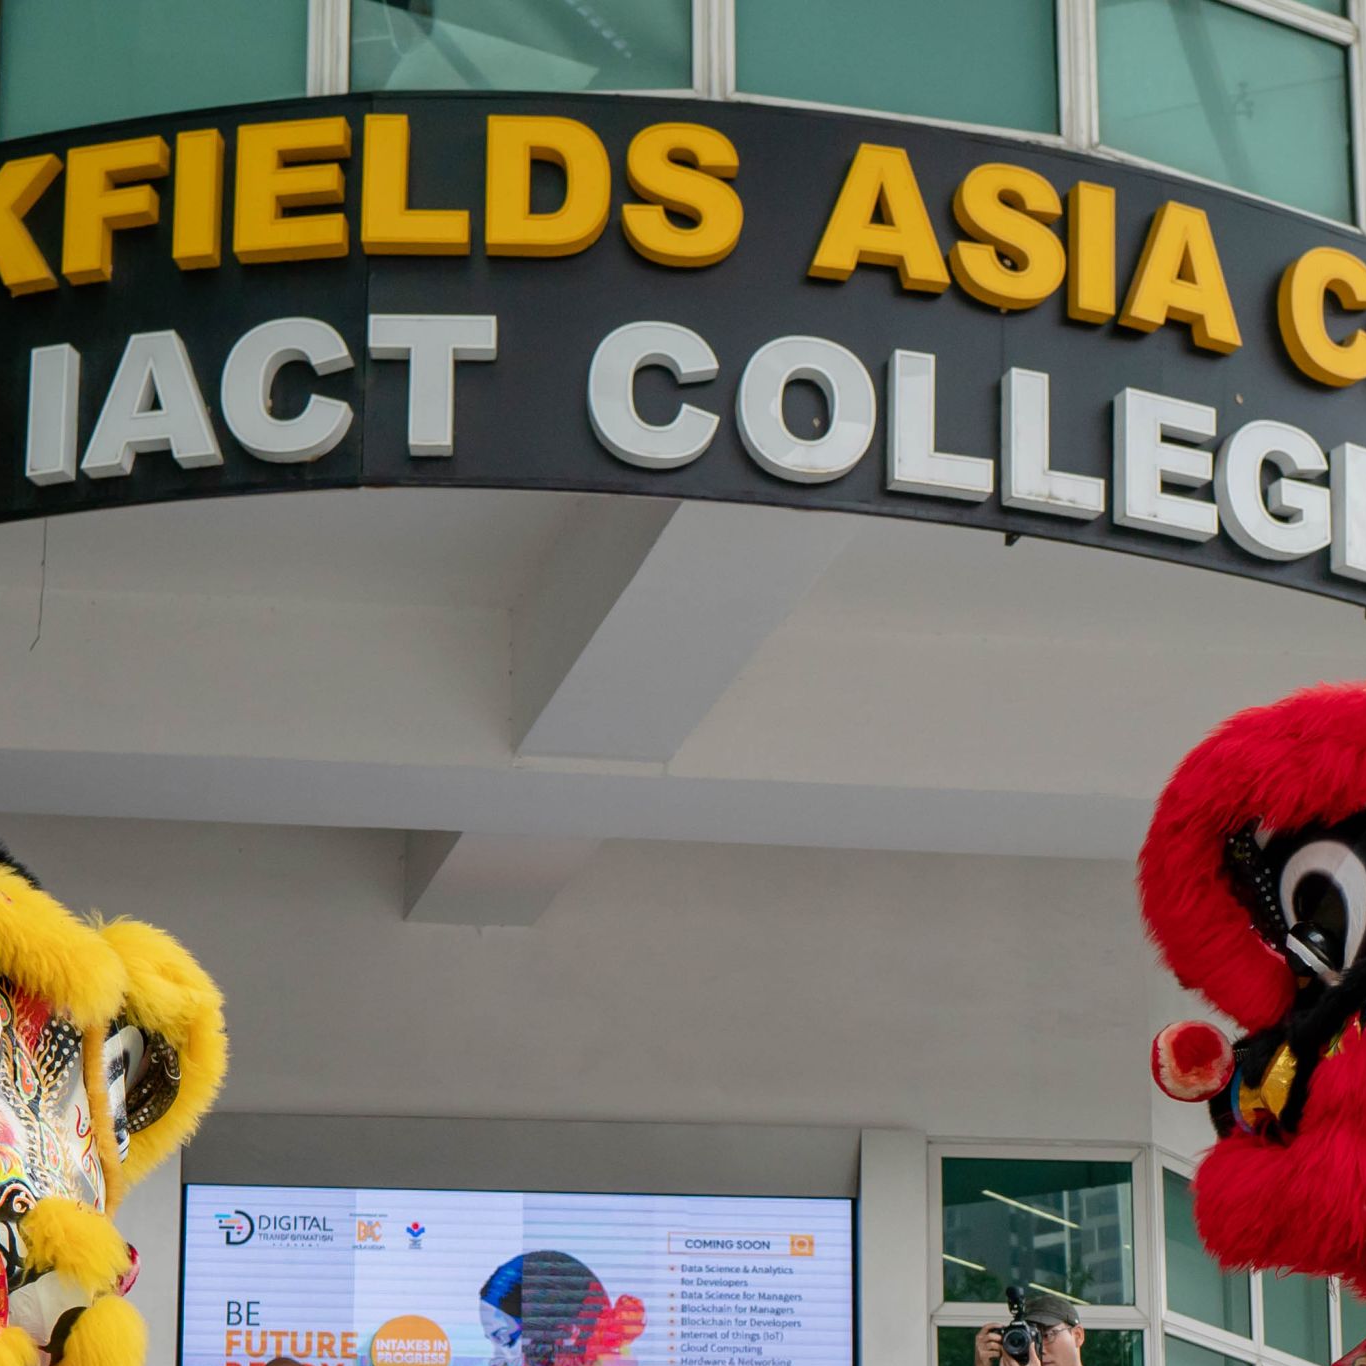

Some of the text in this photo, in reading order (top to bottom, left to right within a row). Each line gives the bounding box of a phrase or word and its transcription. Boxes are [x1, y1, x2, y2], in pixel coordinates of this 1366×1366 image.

[807, 142, 1244, 355] ASIA
[24, 313, 497, 486] IACT
[258, 1215, 334, 1232] DIGITAL
[684, 1239, 771, 1250] COMING SOON
[681, 1264, 794, 1277] Data Science & Analytics
[681, 1277, 749, 1288] for Developers
[681, 1291, 803, 1303] Data Science for Managers
[226, 1301, 261, 1326] BE
[681, 1304, 795, 1316] Blockchain for Managers
[681, 1317, 802, 1329] Blockchain for Developers
[681, 1331, 718, 1340] Internet
[720, 1331, 730, 1340] of
[732, 1331, 761, 1342] things
[225, 1330, 359, 1360] FUTURE
[376, 1339, 448, 1351] INTAKES IN
[681, 1343, 763, 1356] Cloud Computing
[376, 1352, 447, 1365] PROGRESS
[681, 1357, 727, 1366] Hardware
